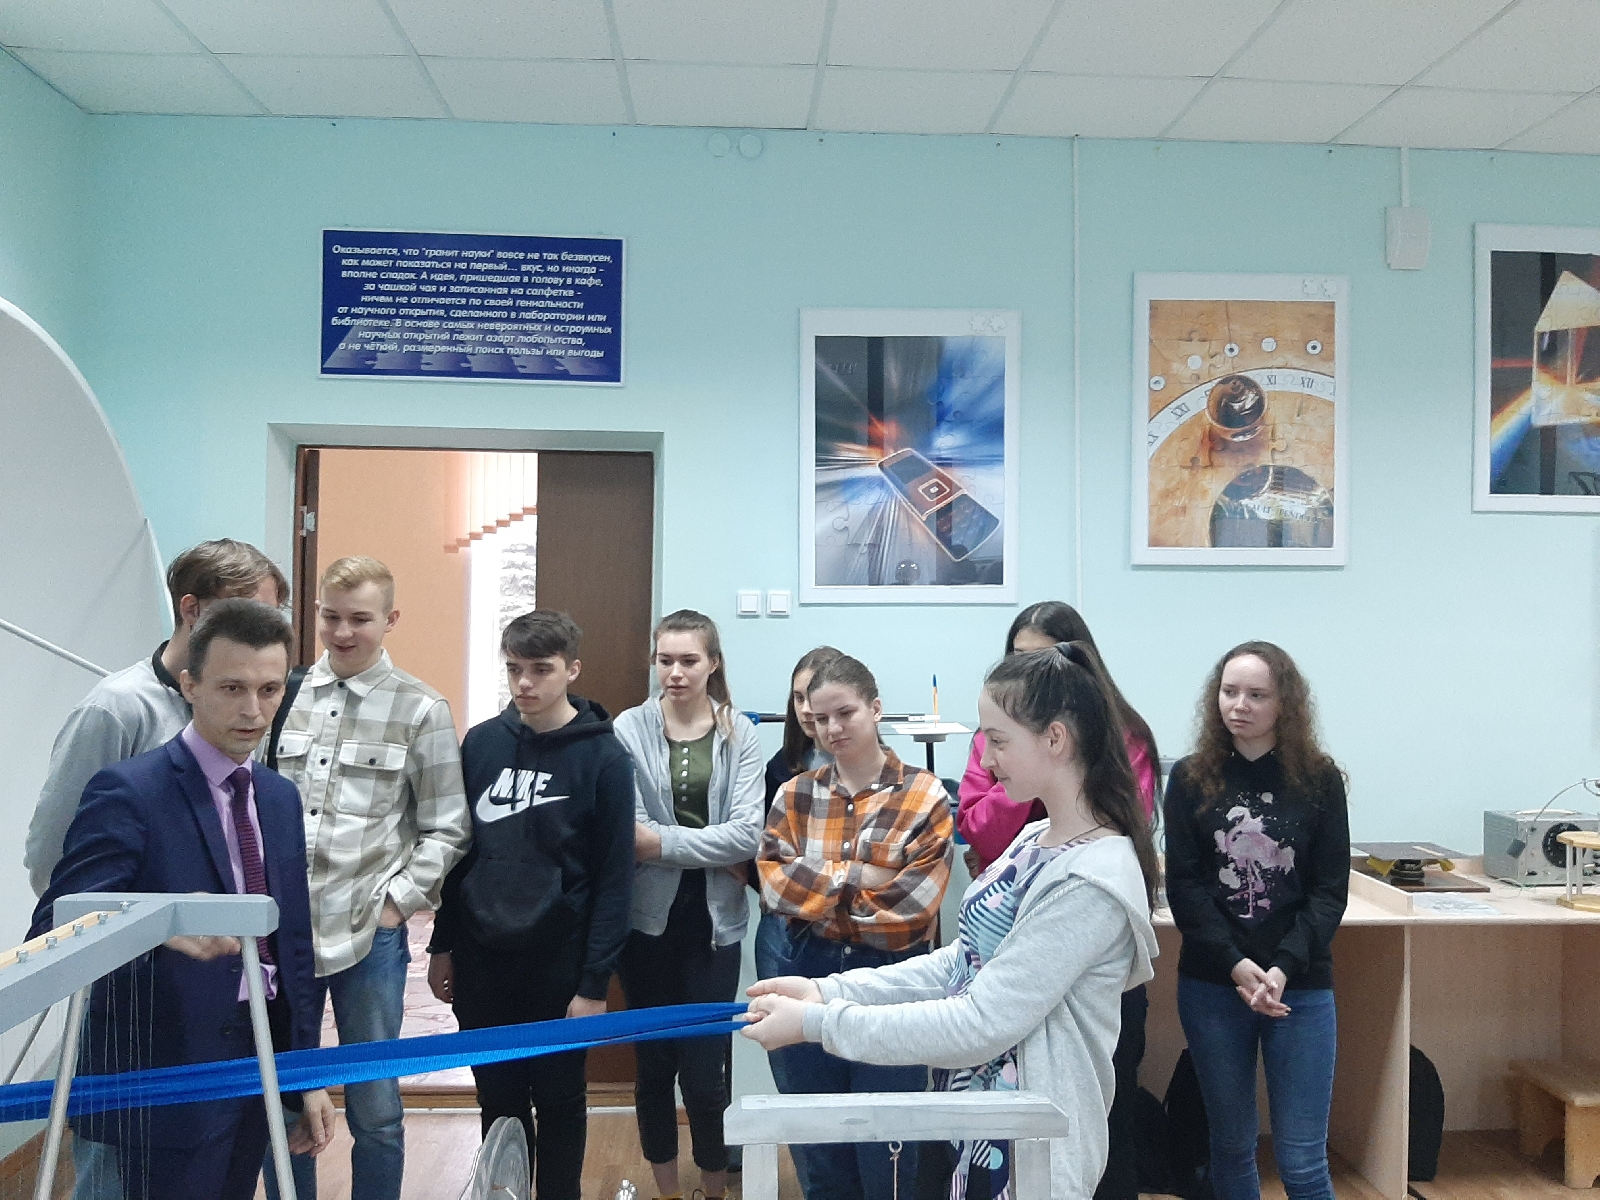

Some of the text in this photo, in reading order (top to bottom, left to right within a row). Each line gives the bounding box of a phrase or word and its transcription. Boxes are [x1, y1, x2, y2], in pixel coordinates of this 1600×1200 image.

[497, 251, 524, 259] вовсе
[341, 258, 359, 266] как
[361, 259, 393, 267] может
[396, 260, 451, 268] показаться
[562, 265, 596, 274] иногда
[341, 270, 378, 278] вполне
[460, 274, 520, 283] пришедшая
[532, 276, 564, 286] голову
[378, 283, 416, 291] чашкой
[449, 286, 508, 294] записанная
[526, 287, 574, 297] салфетке
[484, 298, 513, 306] своей
[516, 300, 583, 309] гениальности
[351, 307, 396, 316] научного
[450, 309, 507, 318] сделанного
[519, 310, 585, 321] лаборатории
[587, 314, 607, 322] или
[405, 320, 440, 328] основе
[443, 321, 475, 329] самых
[478, 322, 542, 332] невероятных
[358, 331, 401, 339] научных
[403, 331, 450, 340] открытий
[486, 335, 515, 344] азарт
[567, 350, 604, 358] выгоды
